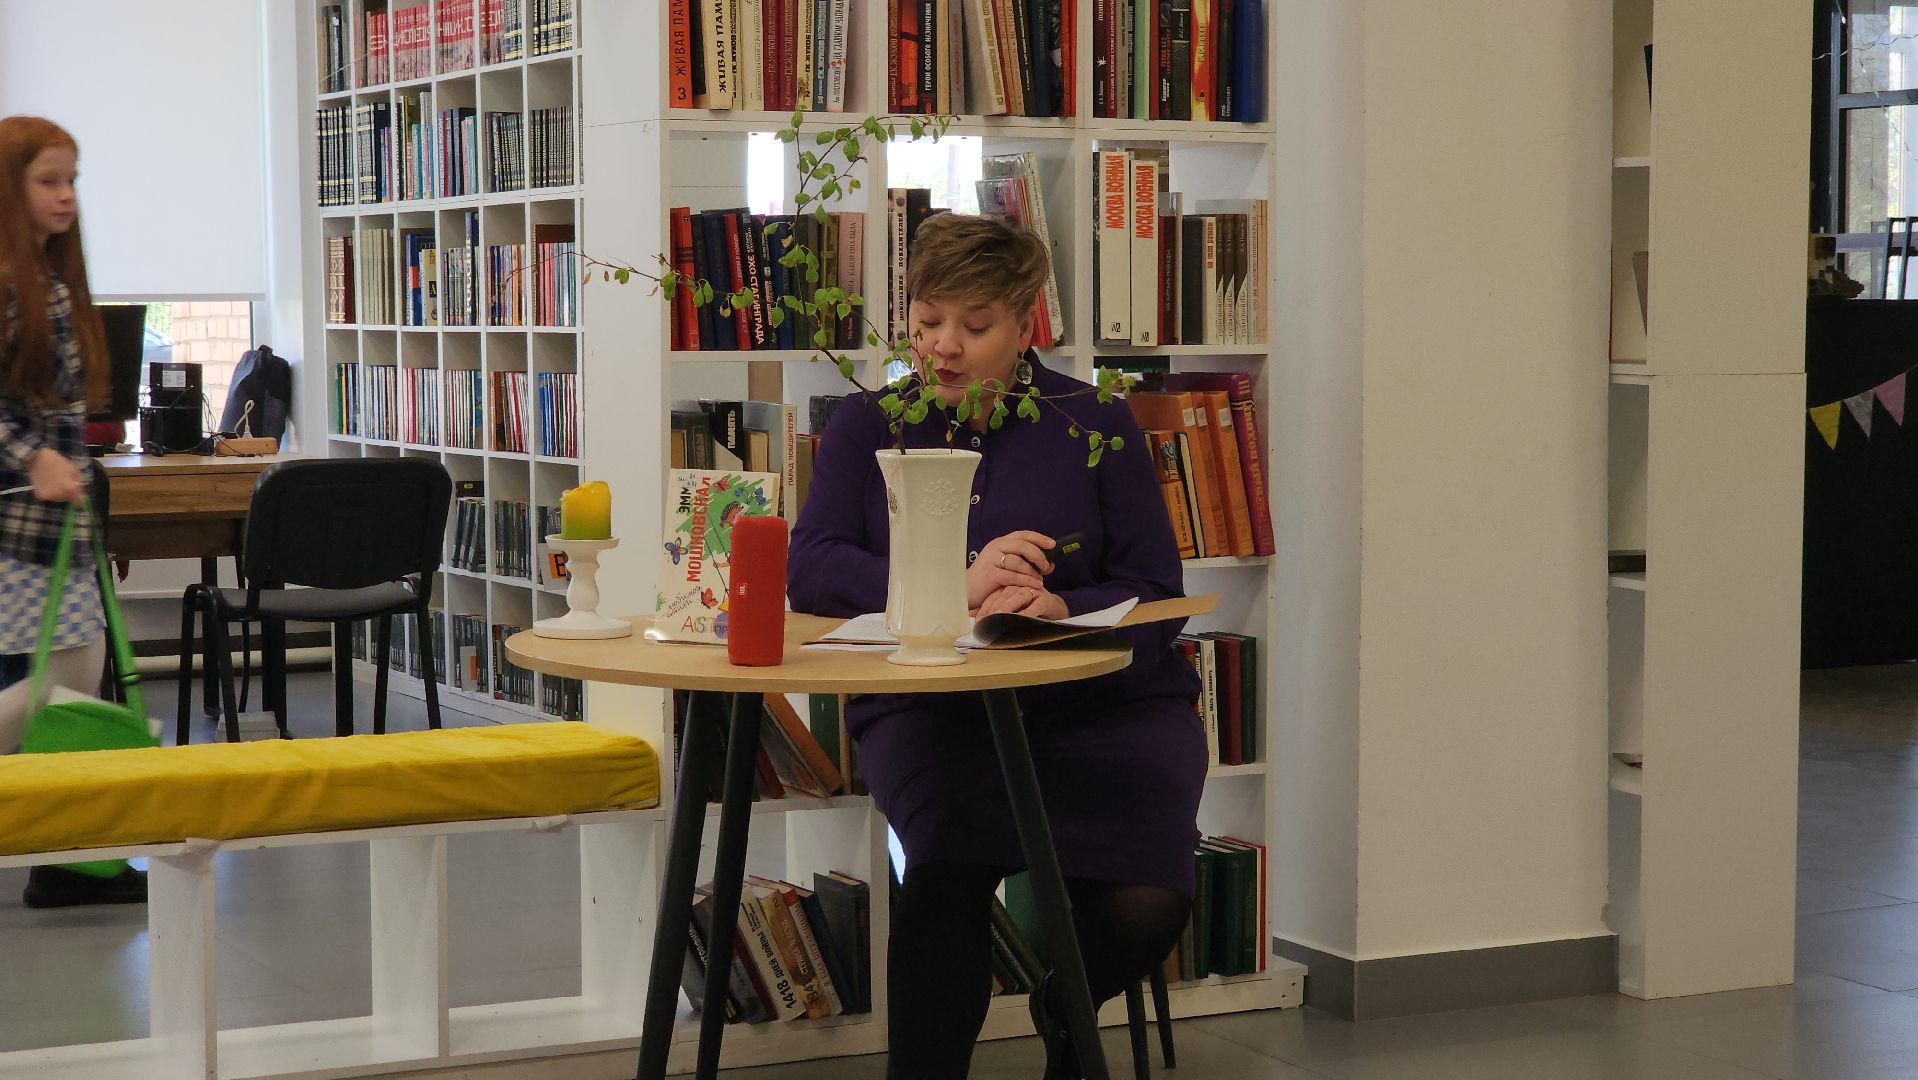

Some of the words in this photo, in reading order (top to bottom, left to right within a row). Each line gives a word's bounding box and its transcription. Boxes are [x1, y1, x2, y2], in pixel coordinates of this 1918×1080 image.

[674, 31, 687, 76] ЖИВАЯ
[717, 41, 727, 93] ЖИВАЯ
[678, 87, 687, 100] 3
[1106, 155, 1124, 193] ВОЕННАЯ
[1136, 165, 1154, 203] ВОЕННАЯ
[1106, 195, 1125, 228] МОСКВА
[1136, 204, 1154, 238] МОСКВА
[748, 254, 757, 275] ЭХО
[727, 410, 736, 449] ПАМЯТЬ
[678, 486, 692, 514] ЭММ
[757, 930, 775, 958] ВОЙНЫ
[767, 958, 785, 979] ДНЕЙ
[776, 979, 798, 1009] 1418
